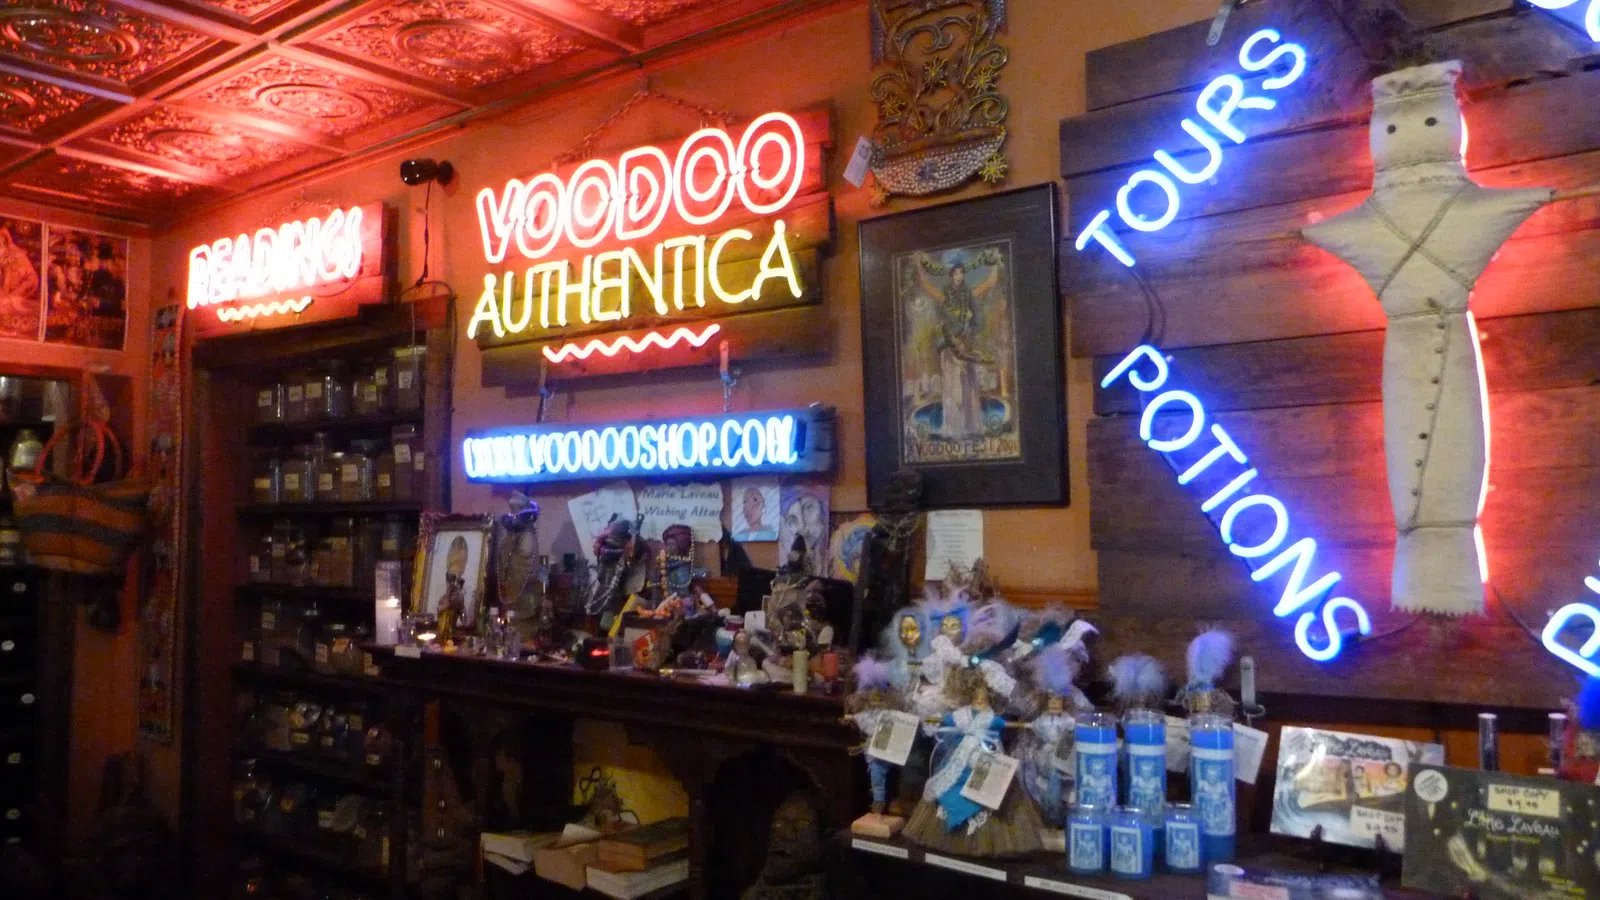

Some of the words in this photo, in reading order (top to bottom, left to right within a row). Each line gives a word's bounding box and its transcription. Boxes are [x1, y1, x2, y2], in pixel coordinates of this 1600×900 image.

[476, 111, 804, 263] VOODOO
[1075, 28, 1307, 267] TOURS
[186, 206, 363, 310] READINGS
[467, 219, 803, 339] AUTHENTICA
[643, 487, 675, 498] Marie
[680, 486, 719, 499] Laveau
[645, 505, 687, 519] Wishing
[691, 505, 719, 516] Altar
[1101, 344, 1371, 662] POTIONS
